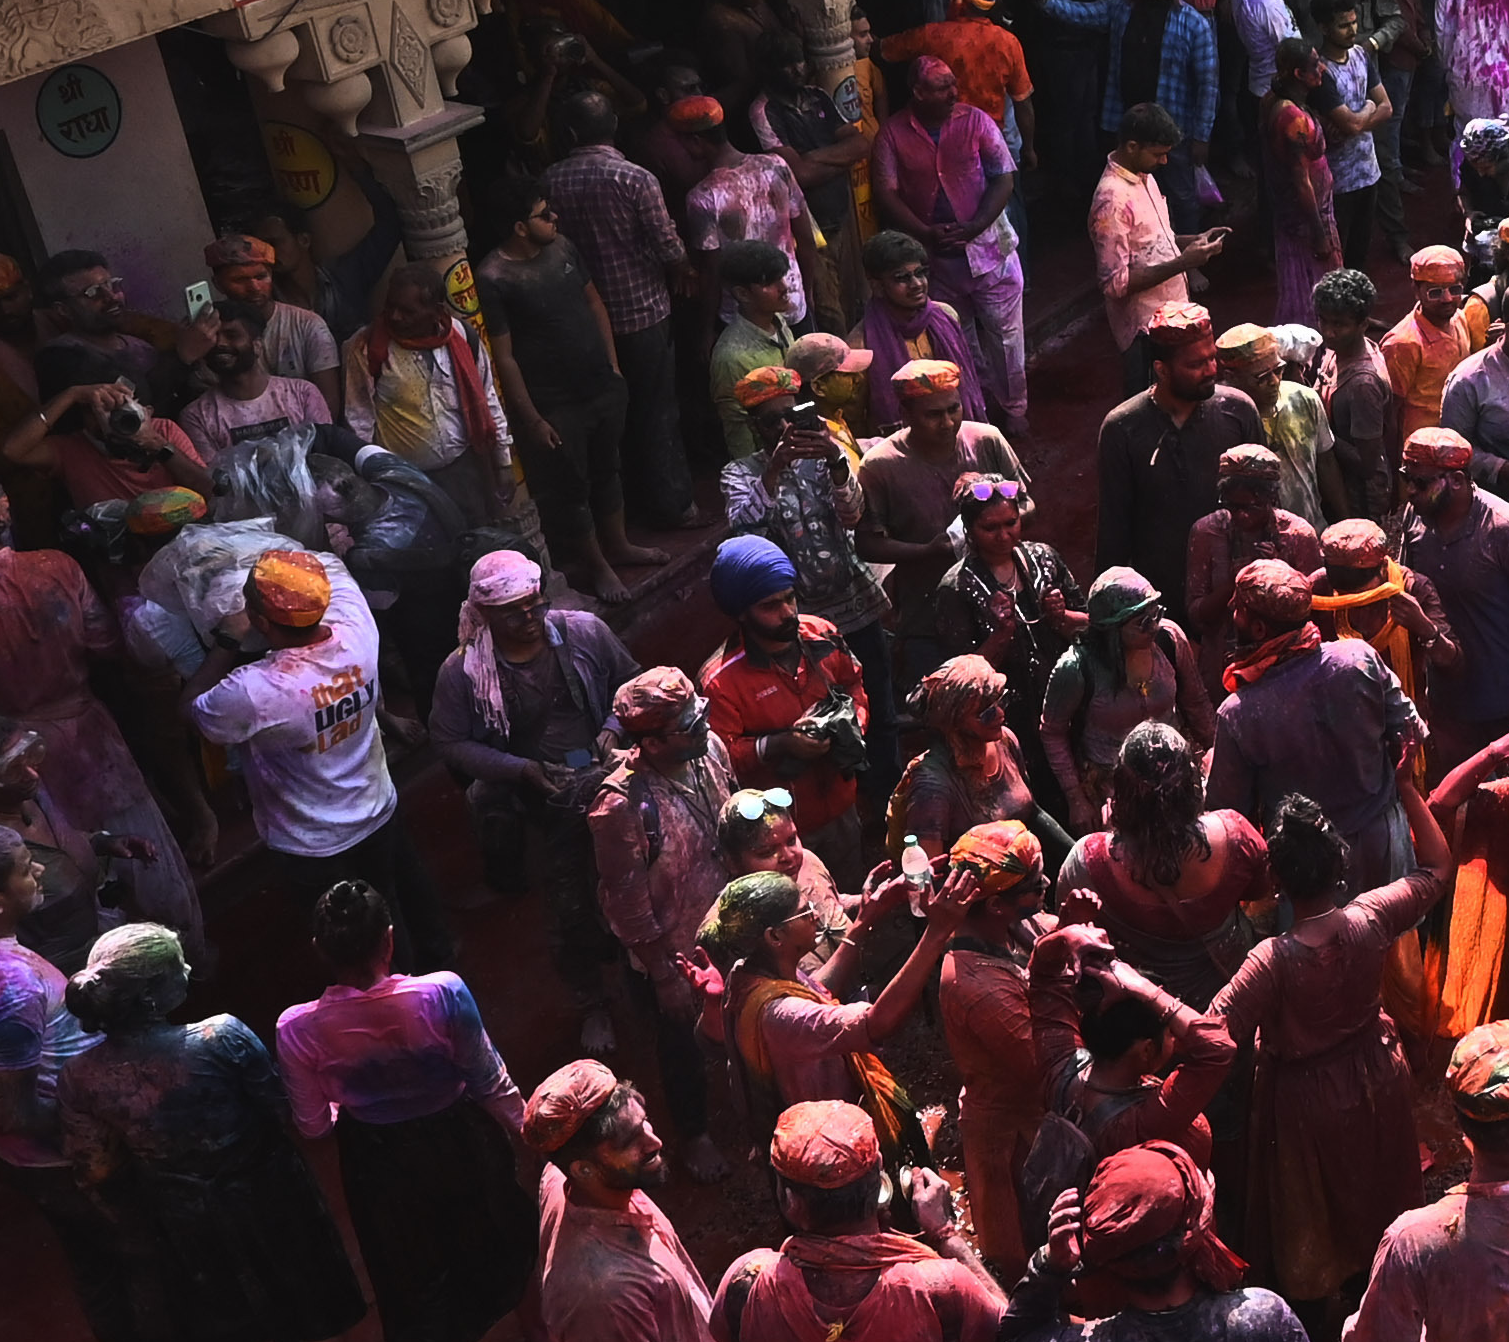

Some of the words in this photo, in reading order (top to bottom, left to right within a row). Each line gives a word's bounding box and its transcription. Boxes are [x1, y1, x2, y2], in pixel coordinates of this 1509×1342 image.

[58, 72, 83, 105] श्री
[56, 106, 112, 143] राधा
[311, 664, 366, 710] that
